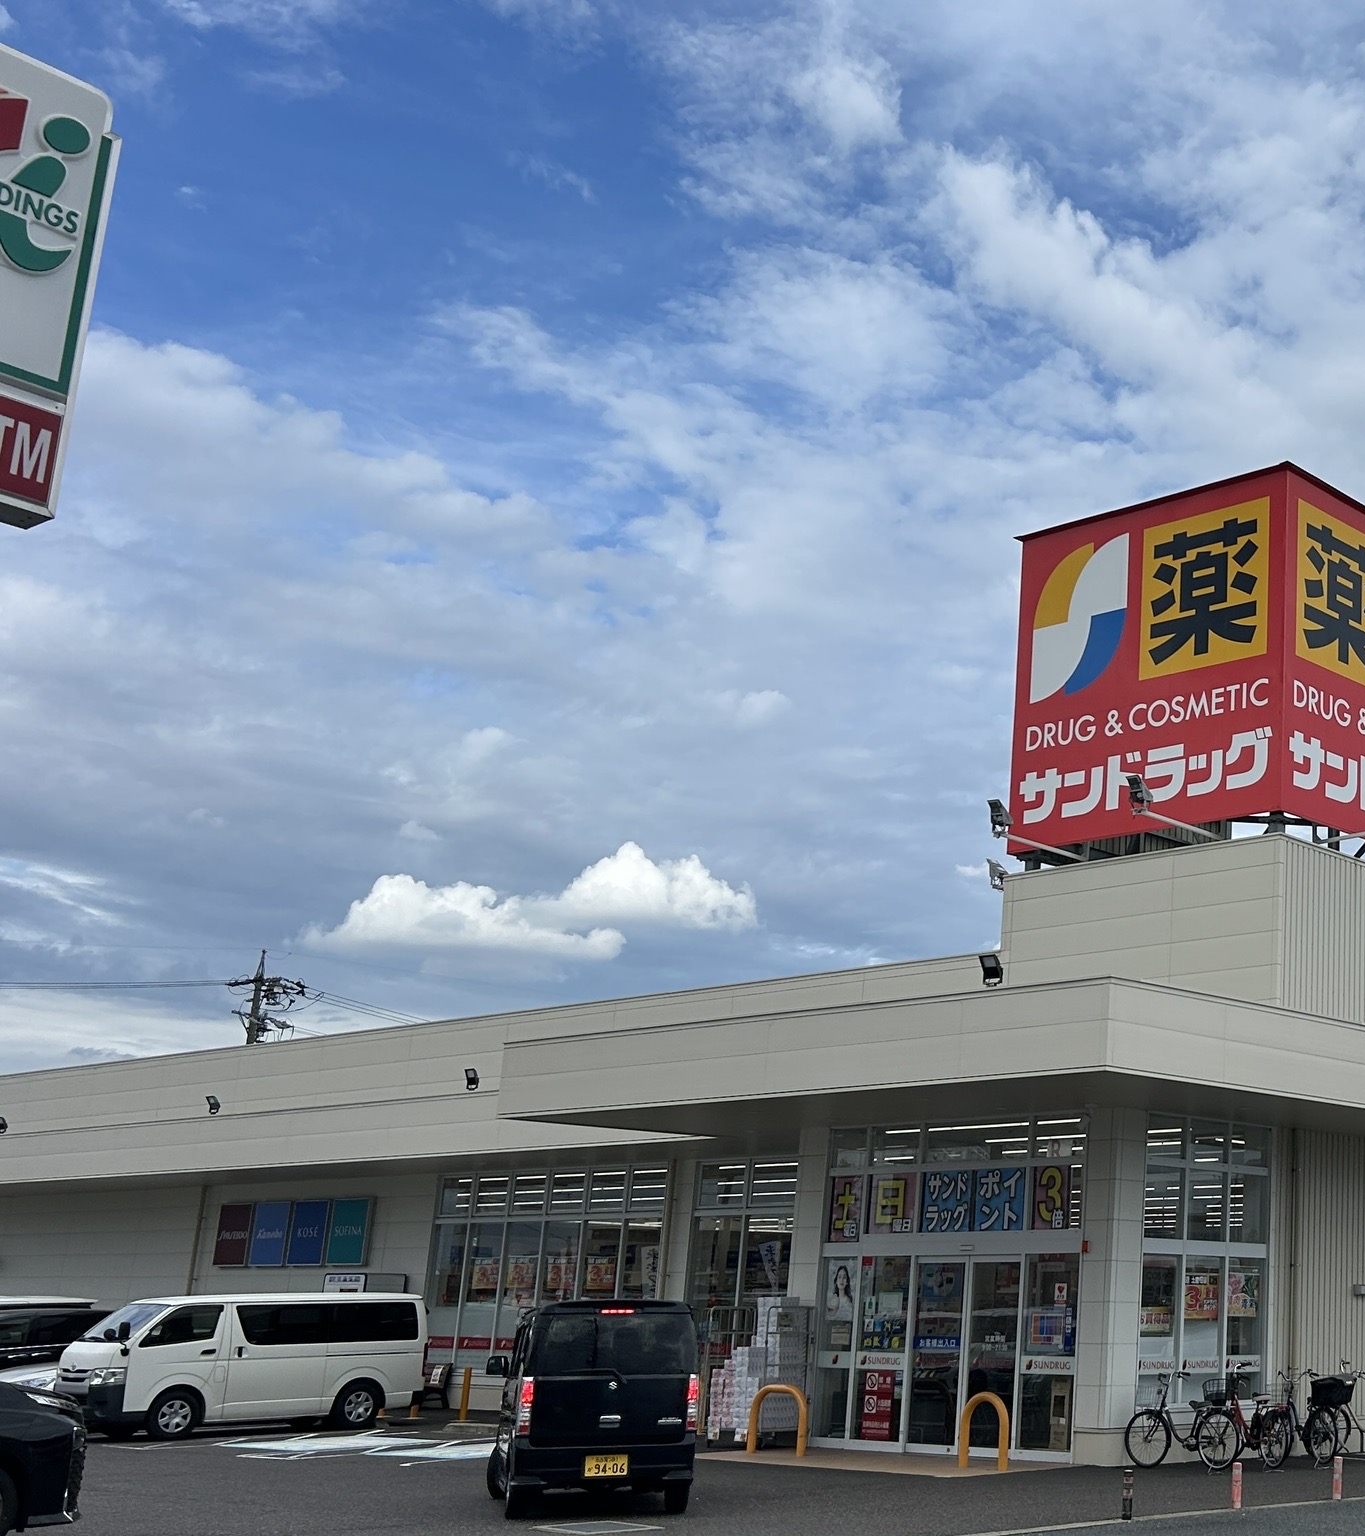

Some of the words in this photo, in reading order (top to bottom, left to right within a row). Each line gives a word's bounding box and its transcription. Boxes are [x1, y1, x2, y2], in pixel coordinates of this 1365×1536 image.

[0, 182, 78, 233] DINGS
[1149, 518, 1258, 665] 薬
[1025, 714, 1096, 752] DRUG
[1104, 709, 1124, 734] &
[1128, 678, 1269, 731] COSMETIC
[1293, 680, 1351, 727] DRUG
[1019, 726, 1274, 824] サンドラッグ
[928, 1172, 968, 1200] サンド
[979, 1169, 1023, 1198] ポイ
[1038, 1167, 1062, 1222] 3
[925, 1203, 968, 1231] ラッグ
[979, 1202, 1018, 1230] ント
[297, 1226, 319, 1238] KOSÉ
[334, 1225, 362, 1236] SOFINA
[867, 1356, 900, 1365] SUNDRUG
[1033, 1360, 1071, 1370] SUNDRUG
[1142, 1360, 1175, 1370] SUNDRUG
[1187, 1359, 1219, 1369] SUNDRUG
[1230, 1359, 1260, 1368] SUUG
[594, 1463, 625, 1474] 94-06
